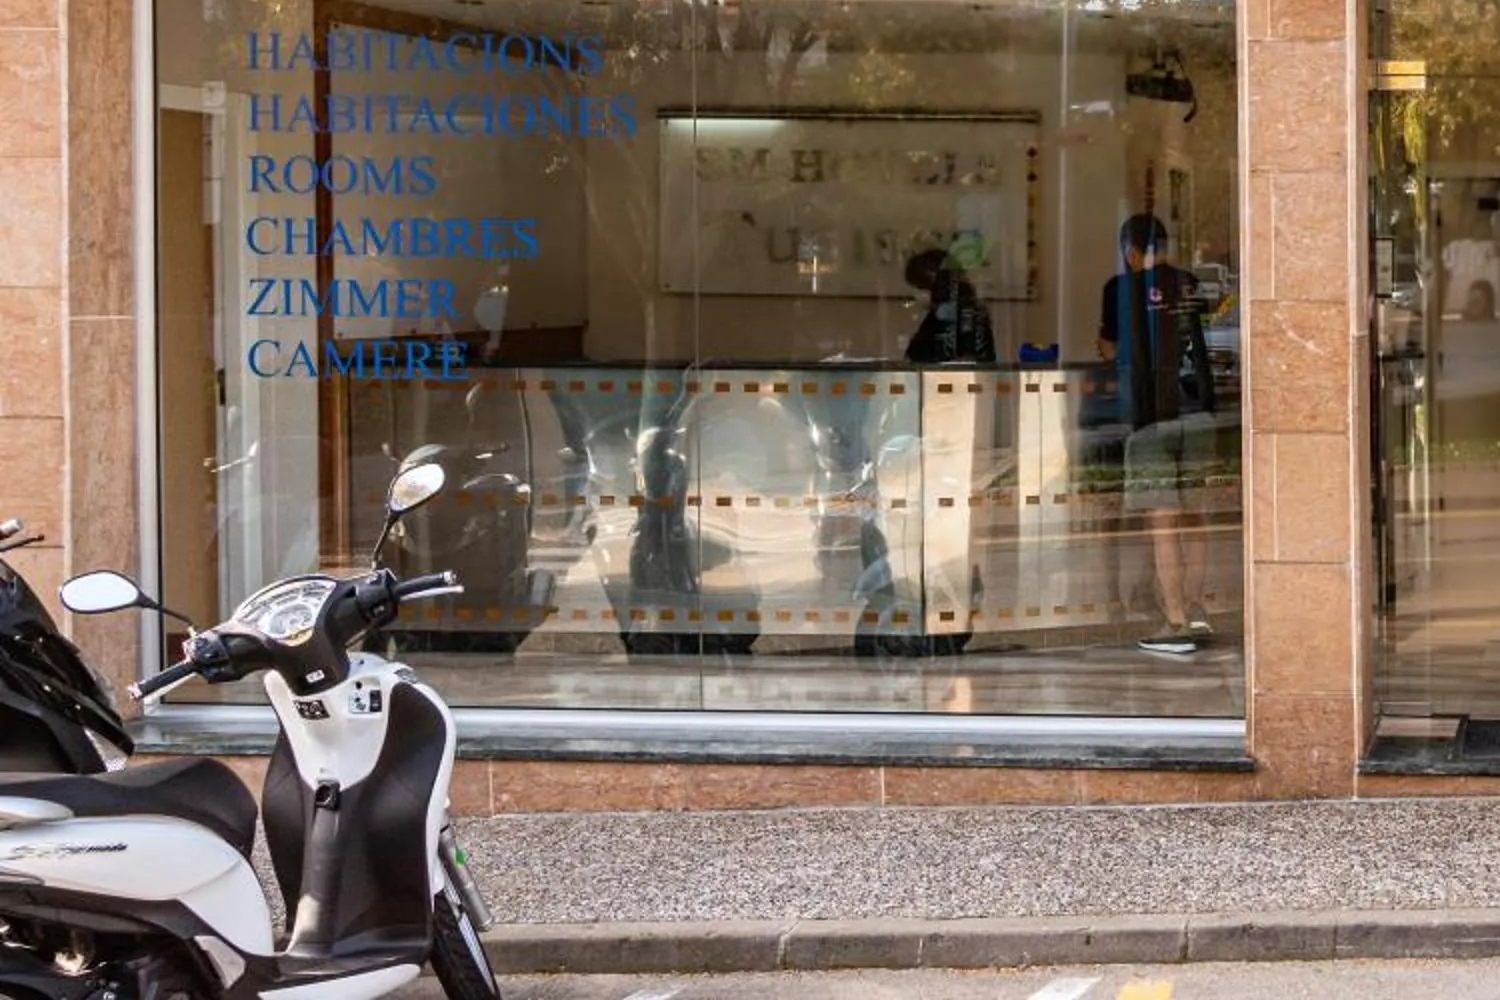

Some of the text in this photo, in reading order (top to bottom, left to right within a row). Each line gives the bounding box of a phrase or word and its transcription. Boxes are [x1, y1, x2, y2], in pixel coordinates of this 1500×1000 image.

[247, 32, 604, 74] HABITACIONS
[247, 94, 637, 137] HABITACIONES
[248, 155, 437, 195] ROOMS
[246, 216, 539, 258] CHAMBRES
[247, 278, 458, 318] ZIMMER
[248, 339, 470, 380] CAMERE
